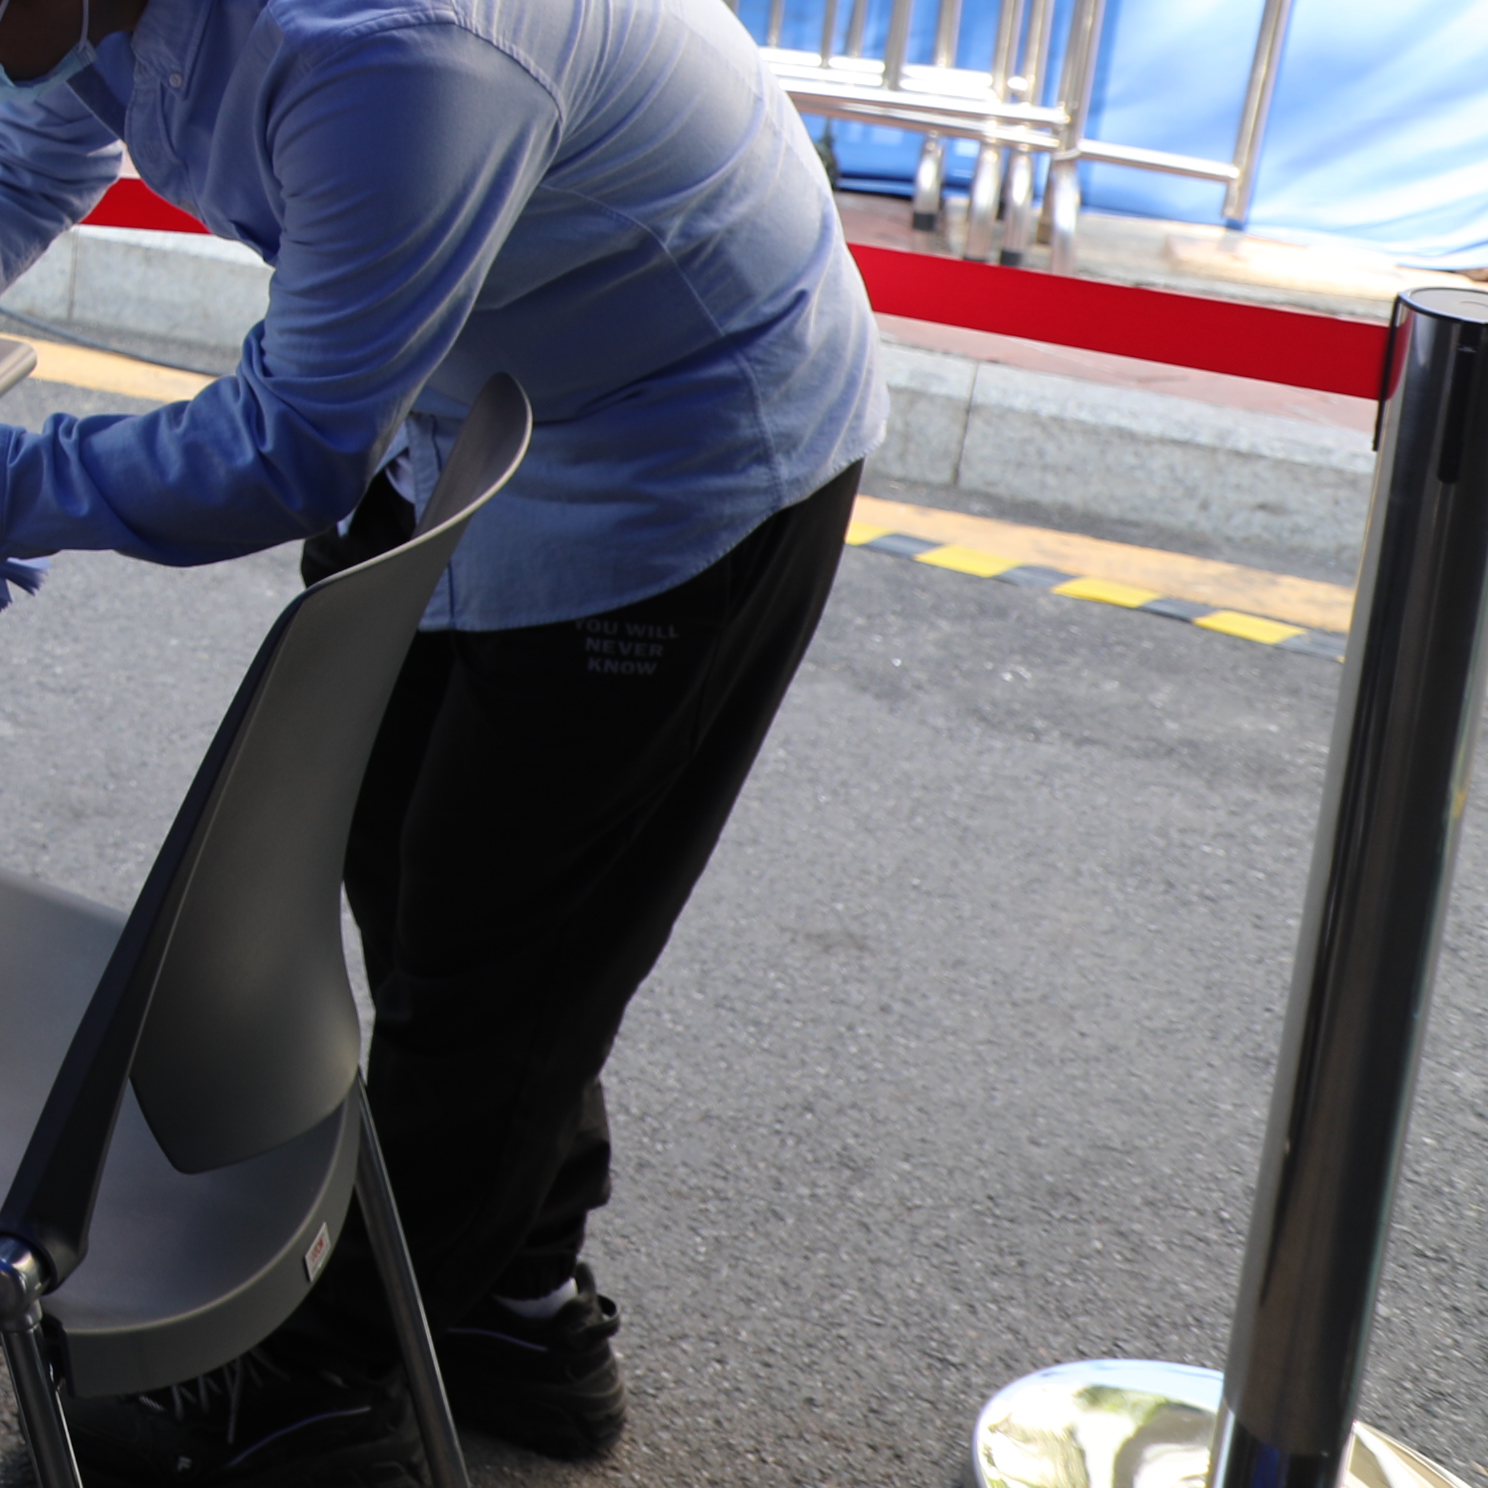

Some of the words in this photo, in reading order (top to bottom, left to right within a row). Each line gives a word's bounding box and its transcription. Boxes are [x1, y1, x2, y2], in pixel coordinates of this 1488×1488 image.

[575, 618, 619, 635] YOU
[626, 622, 680, 639] WILL
[585, 637, 664, 657] NEVER
[587, 657, 658, 676] KNOW
